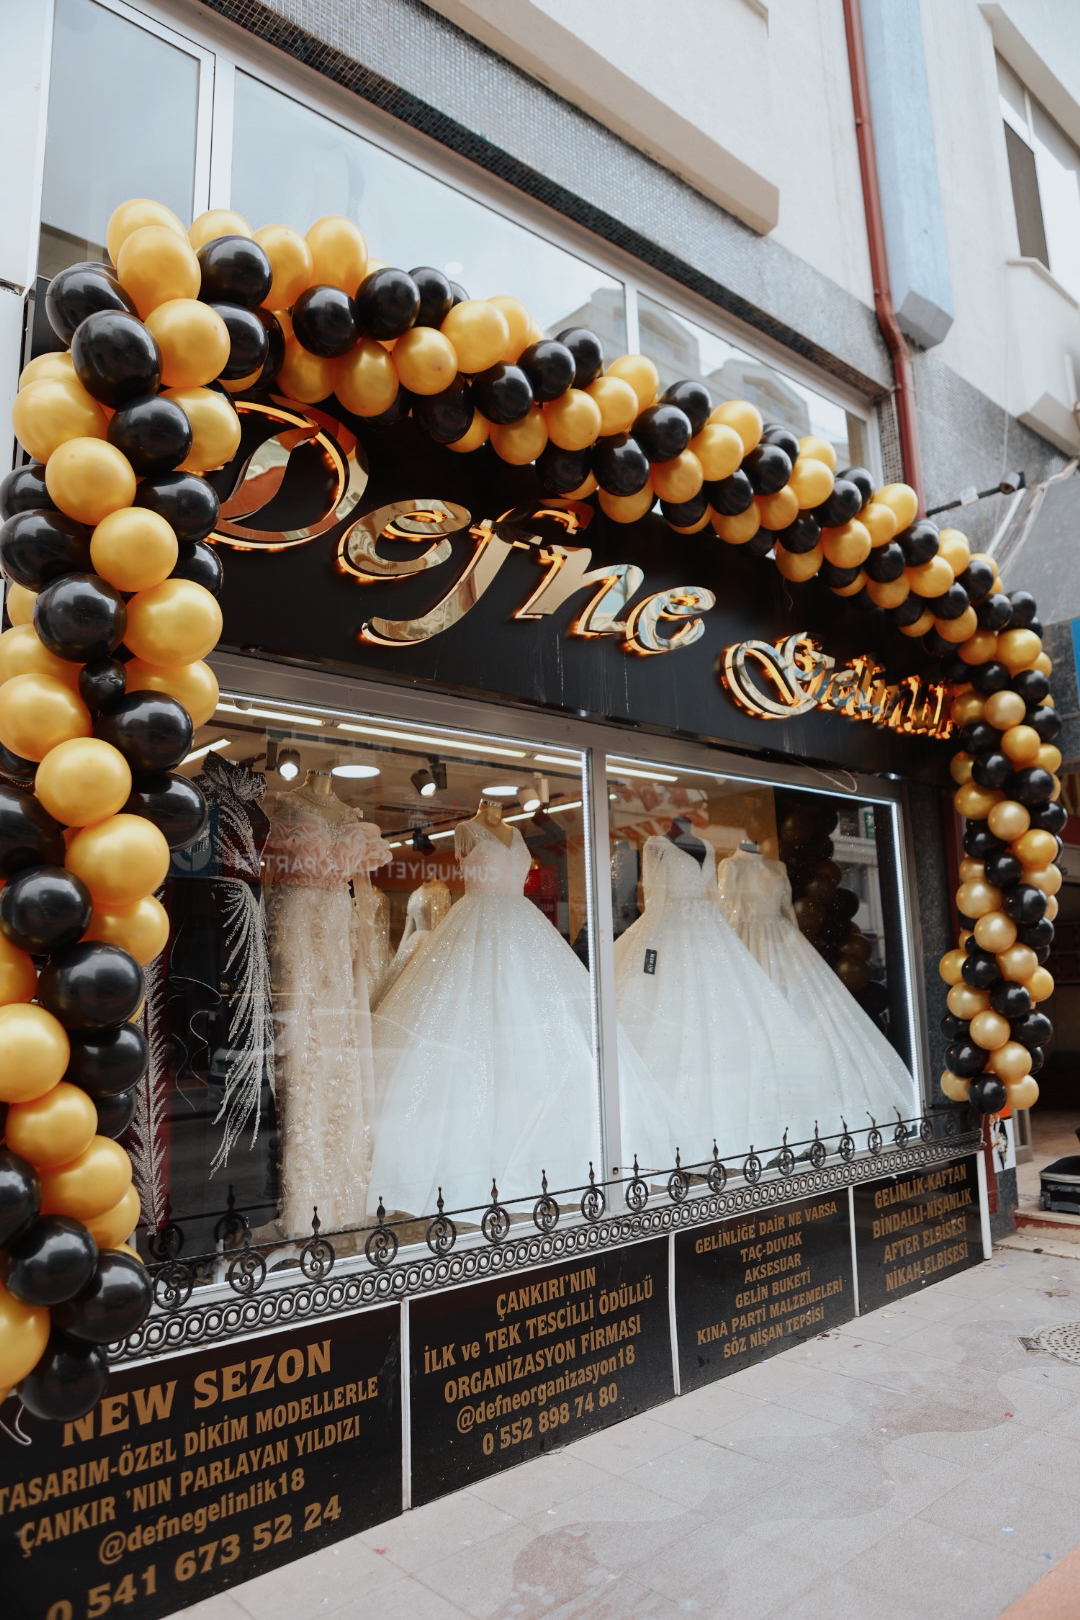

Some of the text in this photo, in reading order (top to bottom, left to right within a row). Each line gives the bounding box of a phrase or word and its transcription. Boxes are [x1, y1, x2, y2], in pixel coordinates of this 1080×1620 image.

[203, 393, 717, 648] Defne
[872, 1188, 972, 1240] BİNDALLI-NİŞANLIK
[874, 1163, 967, 1209] GELİNLİK-KAFTAN
[695, 1201, 838, 1254] GELİNLİĞE DAİR NE VARSA
[740, 1232, 803, 1263] TAÇ-DUVAK
[884, 1212, 967, 1264] AFTER ELBİSESİ
[735, 1267, 811, 1308] GELİN BUKETİ
[743, 1253, 802, 1284] AKSESUAR
[885, 1237, 969, 1292] NİKAH ELBİSESİ
[496, 1266, 596, 1322] ÇANKIRI'NIN
[731, 1304, 767, 1333] PARTİ
[769, 1276, 843, 1319] MALZEMELERİ
[424, 1274, 654, 1375] İLK ve TEK TESCİLLİ ÖDÜLLÜ
[723, 1303, 825, 1358] SÖZ NİŞAN TEPSİSİ
[444, 1314, 642, 1403] ORGANİZASYON FİRMASI
[62, 1339, 332, 1447] NEW SEZON
[456, 1344, 636, 1434] @defneorganizasyon18
[0, 1376, 379, 1516] TASARIM-ÖZEL DİKİM MODELLERLE
[482, 1382, 618, 1455] 0 552 898 74 80
[20, 1496, 117, 1558] ÇANKIR
[179, 1440, 289, 1496] PARLAYAN
[295, 1415, 361, 1457] YILDIZI
[100, 1468, 305, 1565] @defnegelinlik18
[87, 1564, 157, 1619] 541
[174, 1533, 241, 1582] 673
[252, 1513, 293, 1552] 52
[303, 1494, 343, 1533] 24
